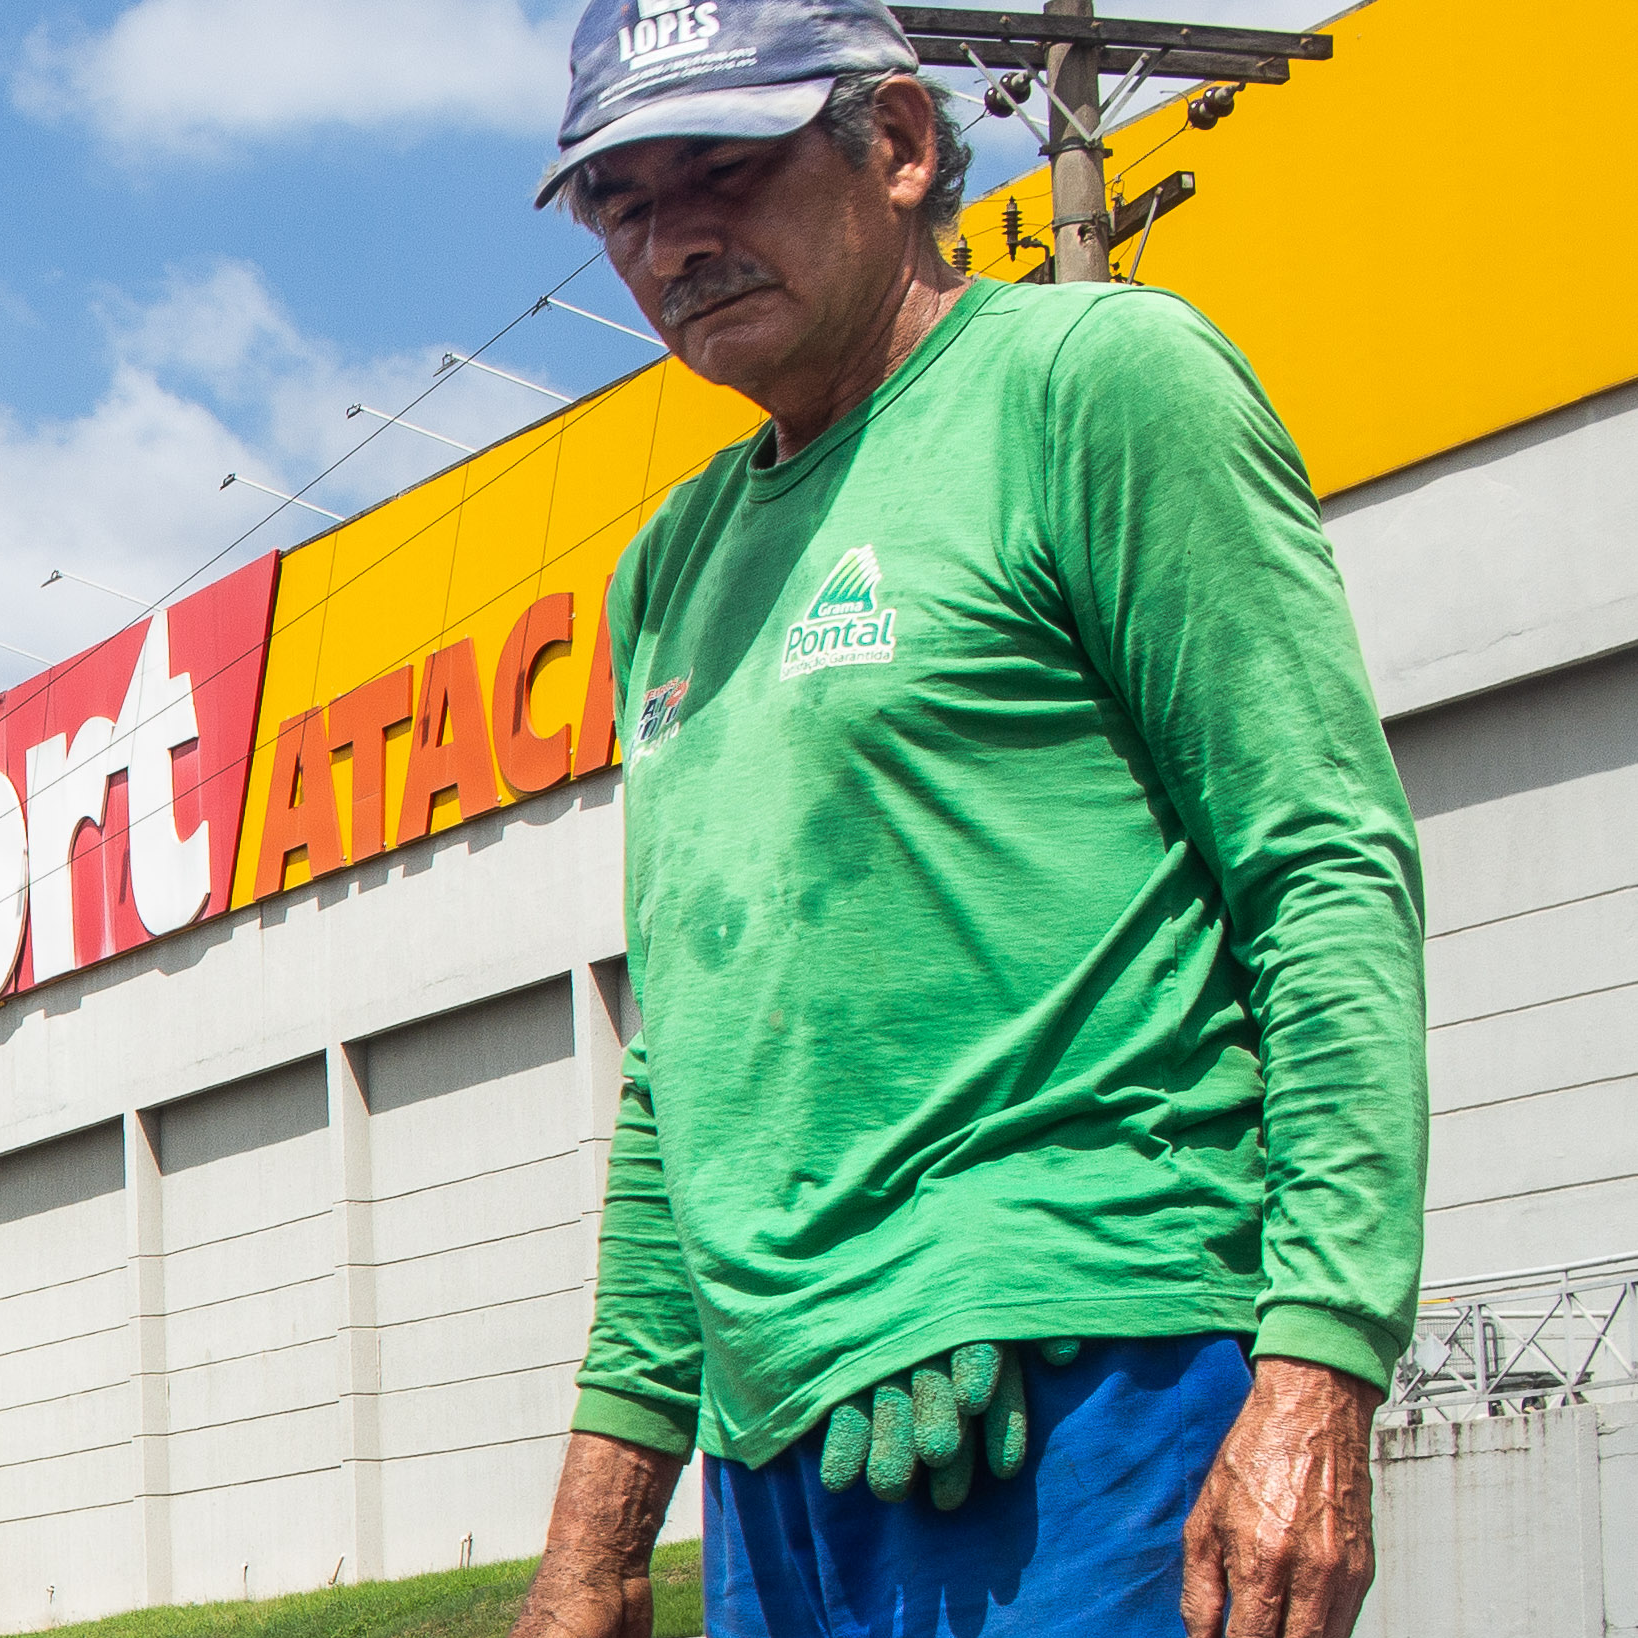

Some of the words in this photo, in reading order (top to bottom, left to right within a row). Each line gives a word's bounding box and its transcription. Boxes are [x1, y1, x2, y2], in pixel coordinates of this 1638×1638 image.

[618, 1, 721, 62] LOPES
[818, 600, 865, 617] Grama
[784, 612, 893, 664] Pontal
[830, 650, 891, 664] Garantida
